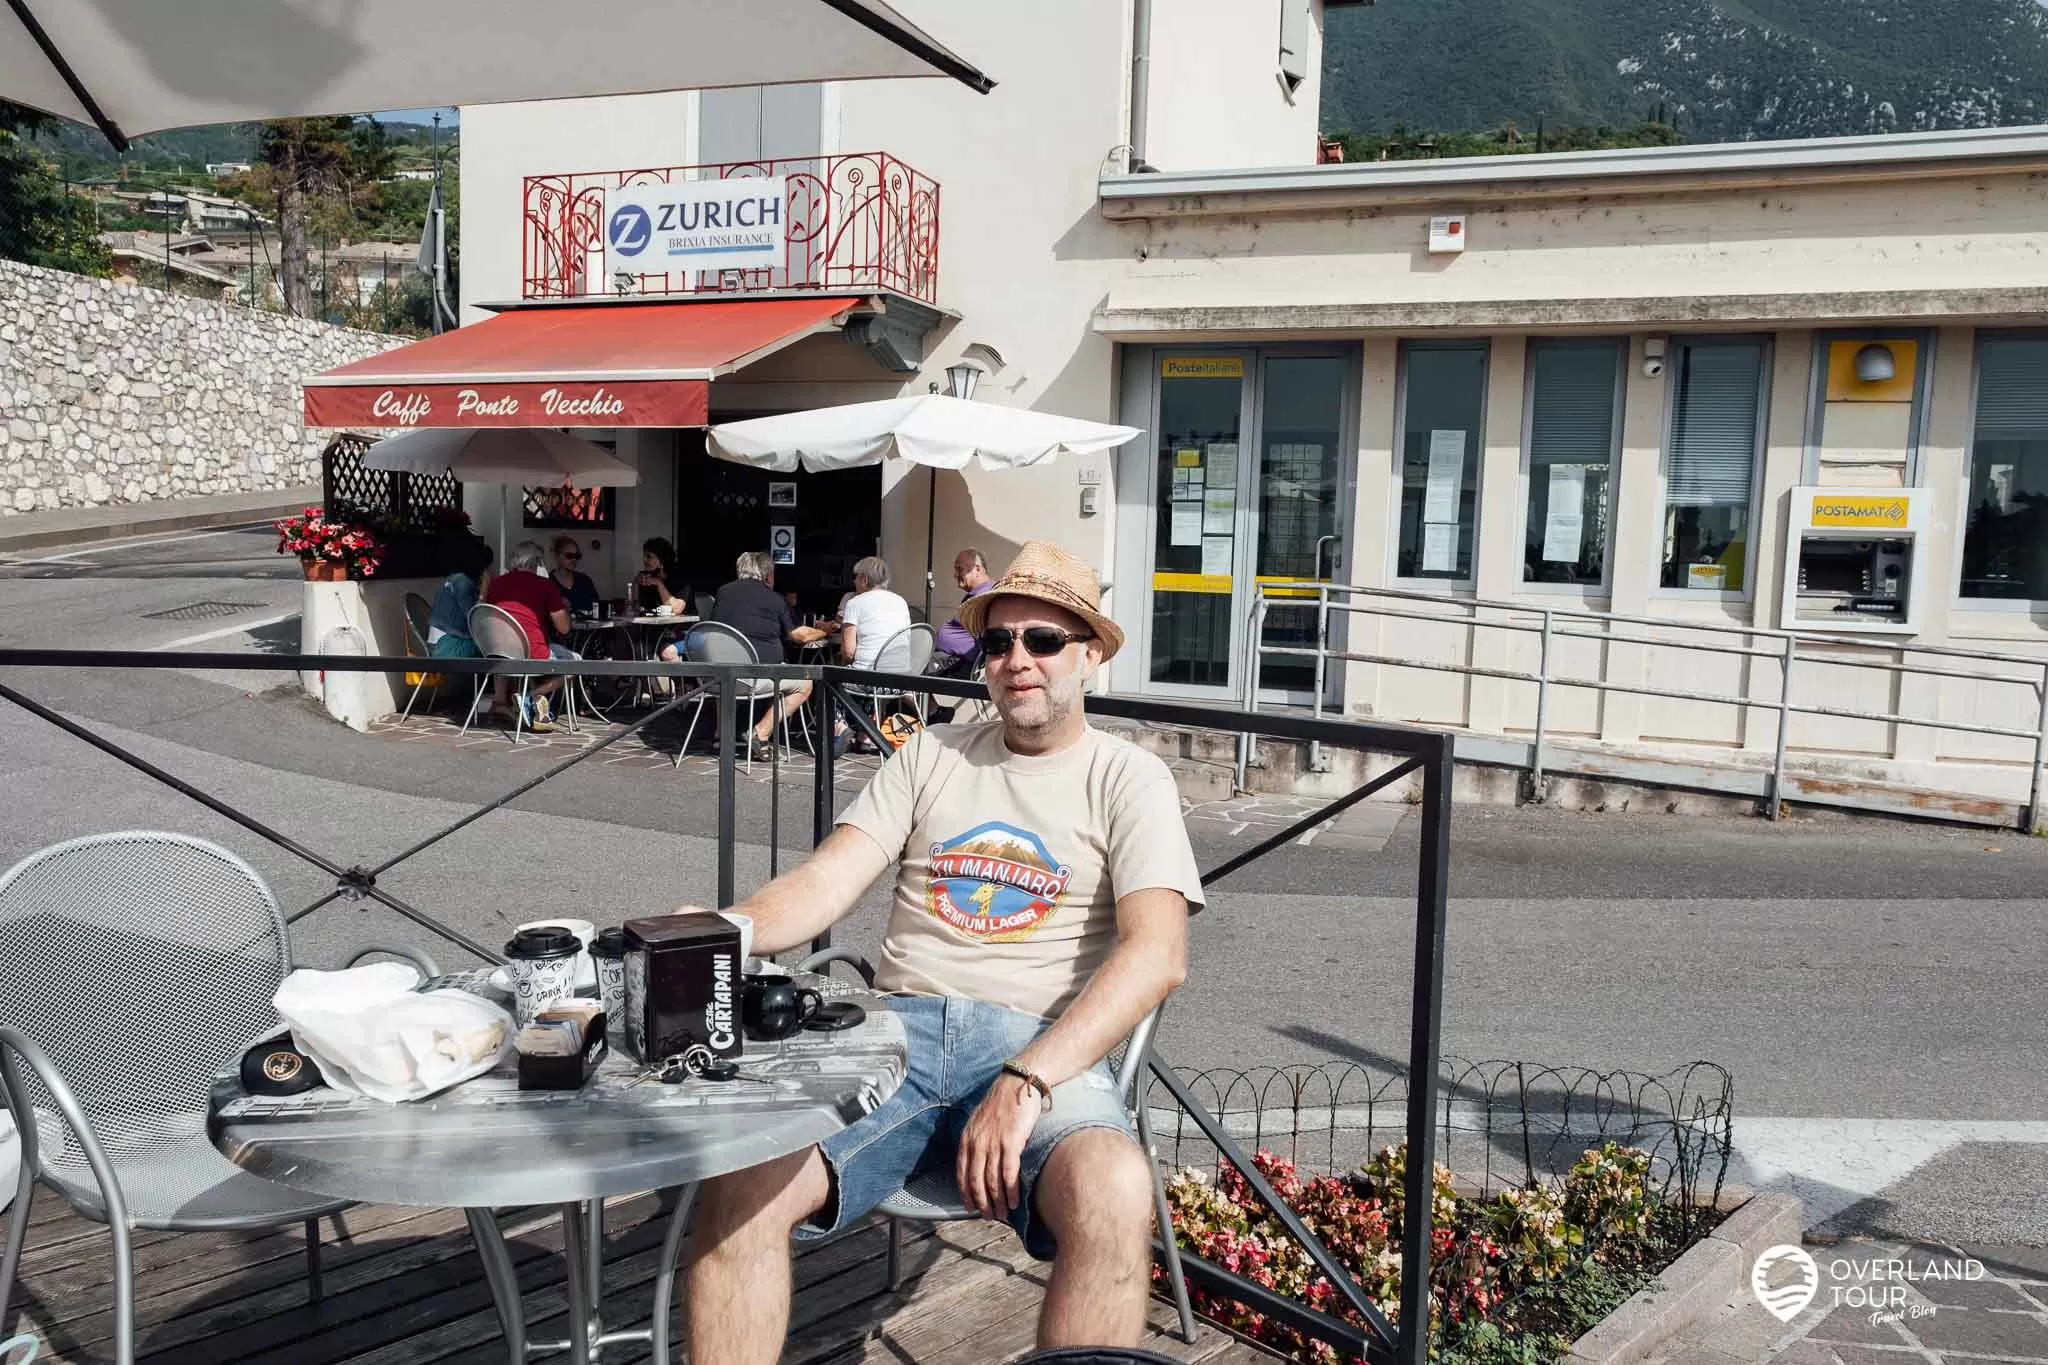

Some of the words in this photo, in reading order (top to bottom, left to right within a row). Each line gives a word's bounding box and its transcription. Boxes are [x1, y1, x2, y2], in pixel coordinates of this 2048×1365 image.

[657, 197, 780, 232] ZURICH
[668, 236, 706, 249] BRIXIA
[708, 232, 774, 247] INSURANCE
[372, 390, 432, 424] Caffè
[456, 389, 520, 417] Ponte
[539, 388, 625, 416] Vecchio
[1815, 504, 1885, 518] POSTAMAT
[935, 892, 986, 931] PREMIUM
[989, 908, 1039, 931] LAGER
[709, 954, 735, 1050] CARTAPANI
